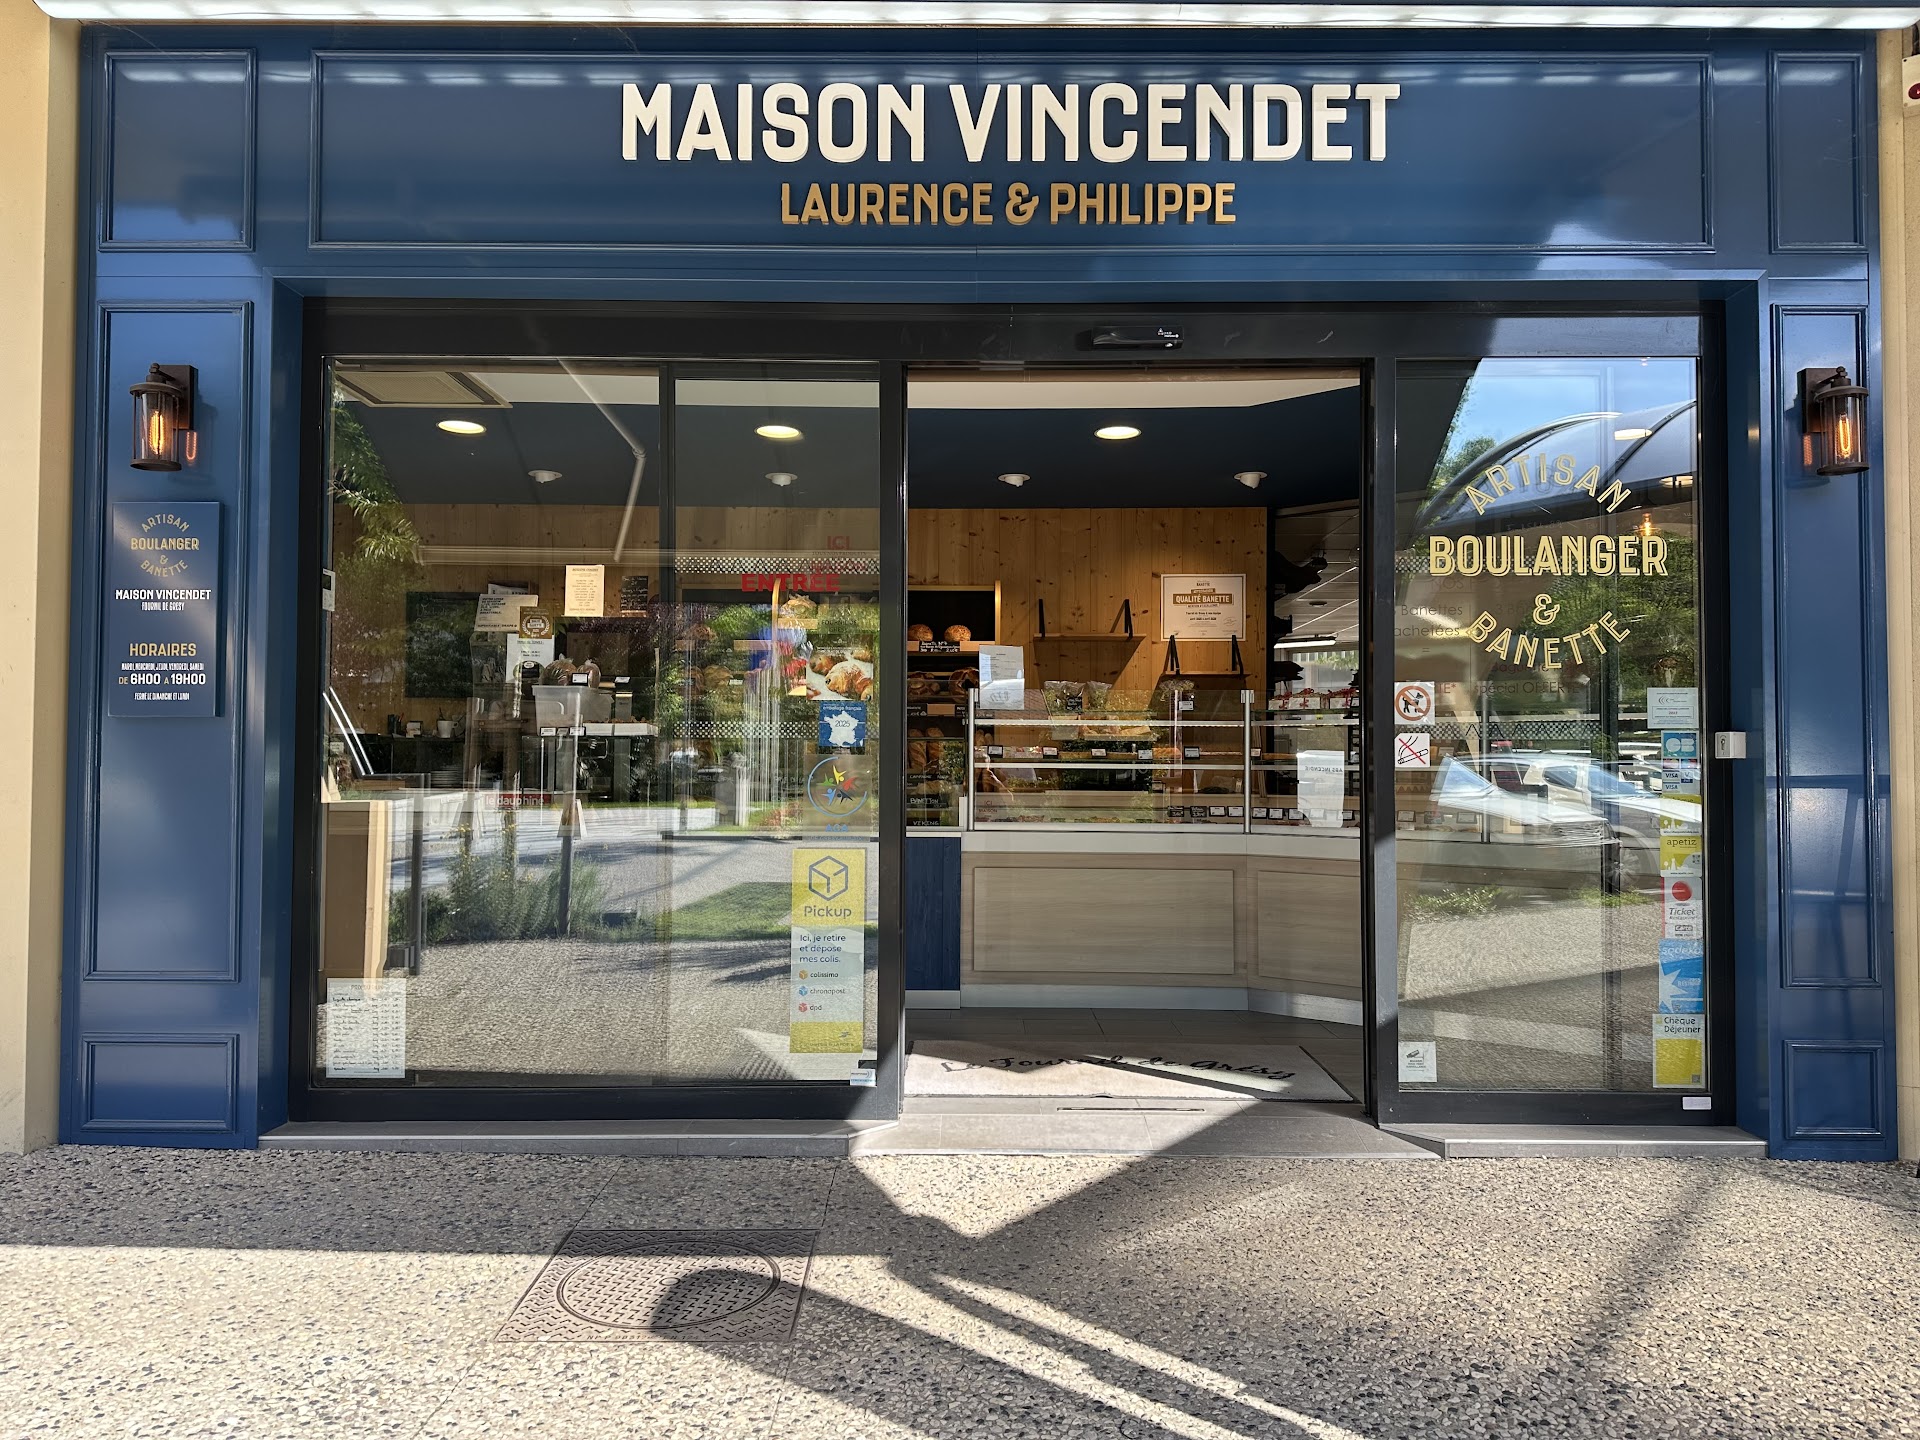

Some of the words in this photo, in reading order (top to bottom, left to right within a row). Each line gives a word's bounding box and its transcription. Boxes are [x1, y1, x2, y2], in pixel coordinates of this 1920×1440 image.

[622, 83, 926, 163] MAISON
[948, 82, 1400, 163] VINCENDET
[781, 182, 993, 226] LAURENCE
[1007, 182, 1040, 226] &
[1050, 182, 1237, 226] PHILIPPE
[1465, 453, 1631, 516] ARTISAN
[141, 513, 190, 533] ARTISAN
[130, 537, 200, 551] BOULANGER
[159, 554, 169, 565] &
[1429, 535, 1668, 577] BOULANGER
[140, 559, 189, 578] BANETTE
[115, 589, 155, 600] MAISON
[156, 589, 212, 600] VINCENDET
[1175, 594, 1202, 603] QUALITÉ
[1203, 595, 1230, 603] BANETTE
[1533, 593, 1561, 625] &
[1467, 610, 1631, 669] BANETTE
[129, 642, 197, 657] HORAIRES
[118, 676, 129, 685] DE
[130, 673, 161, 685] 6H00
[170, 673, 206, 685] 19H00
[1666, 838, 1698, 848] apetiz
[804, 904, 852, 918] Pickup
[1669, 907, 1696, 916] Ticket
[799, 933, 812, 944] Ici,
[813, 934, 822, 945] je
[823, 933, 847, 943] retire
[799, 944, 808, 953] et
[810, 944, 843, 955] dépose
[799, 956, 818, 964] mes
[820, 954, 841, 964] colis.
[809, 987, 846, 996] chronopost
[809, 1004, 823, 1012] dpd
[1664, 1016, 1696, 1026] Chèque
[1664, 1025, 1701, 1035] Déjeuner
[1139, 1055, 1182, 1067] de
